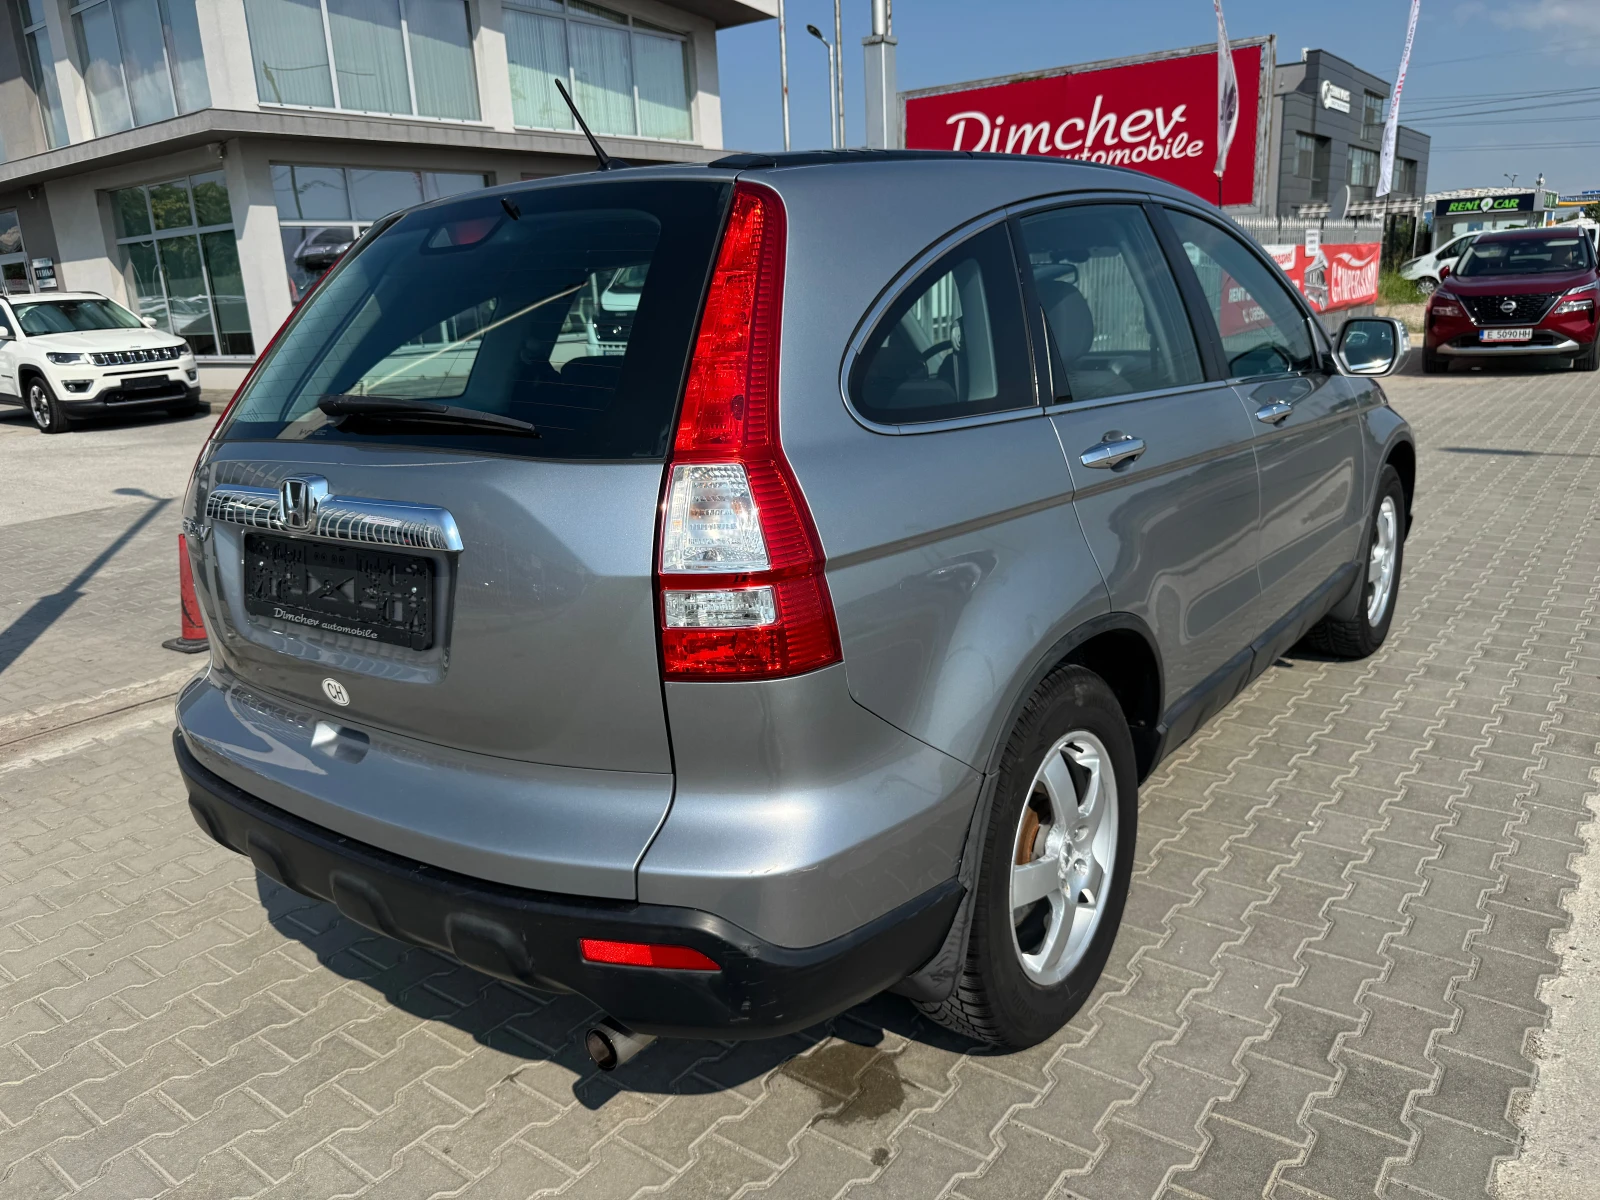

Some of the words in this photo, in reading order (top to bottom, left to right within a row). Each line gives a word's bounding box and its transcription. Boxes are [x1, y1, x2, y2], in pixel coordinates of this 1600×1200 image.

[946, 94, 1187, 155] Dimchev
[1449, 199, 1480, 211] RENT
[1493, 198, 1519, 209] CAR
[1487, 331, 1493, 339] E
[1497, 330, 1518, 339] 5090
[273, 607, 320, 626] Dimchev
[321, 621, 378, 639] automobile
[327, 682, 346, 702] CH
